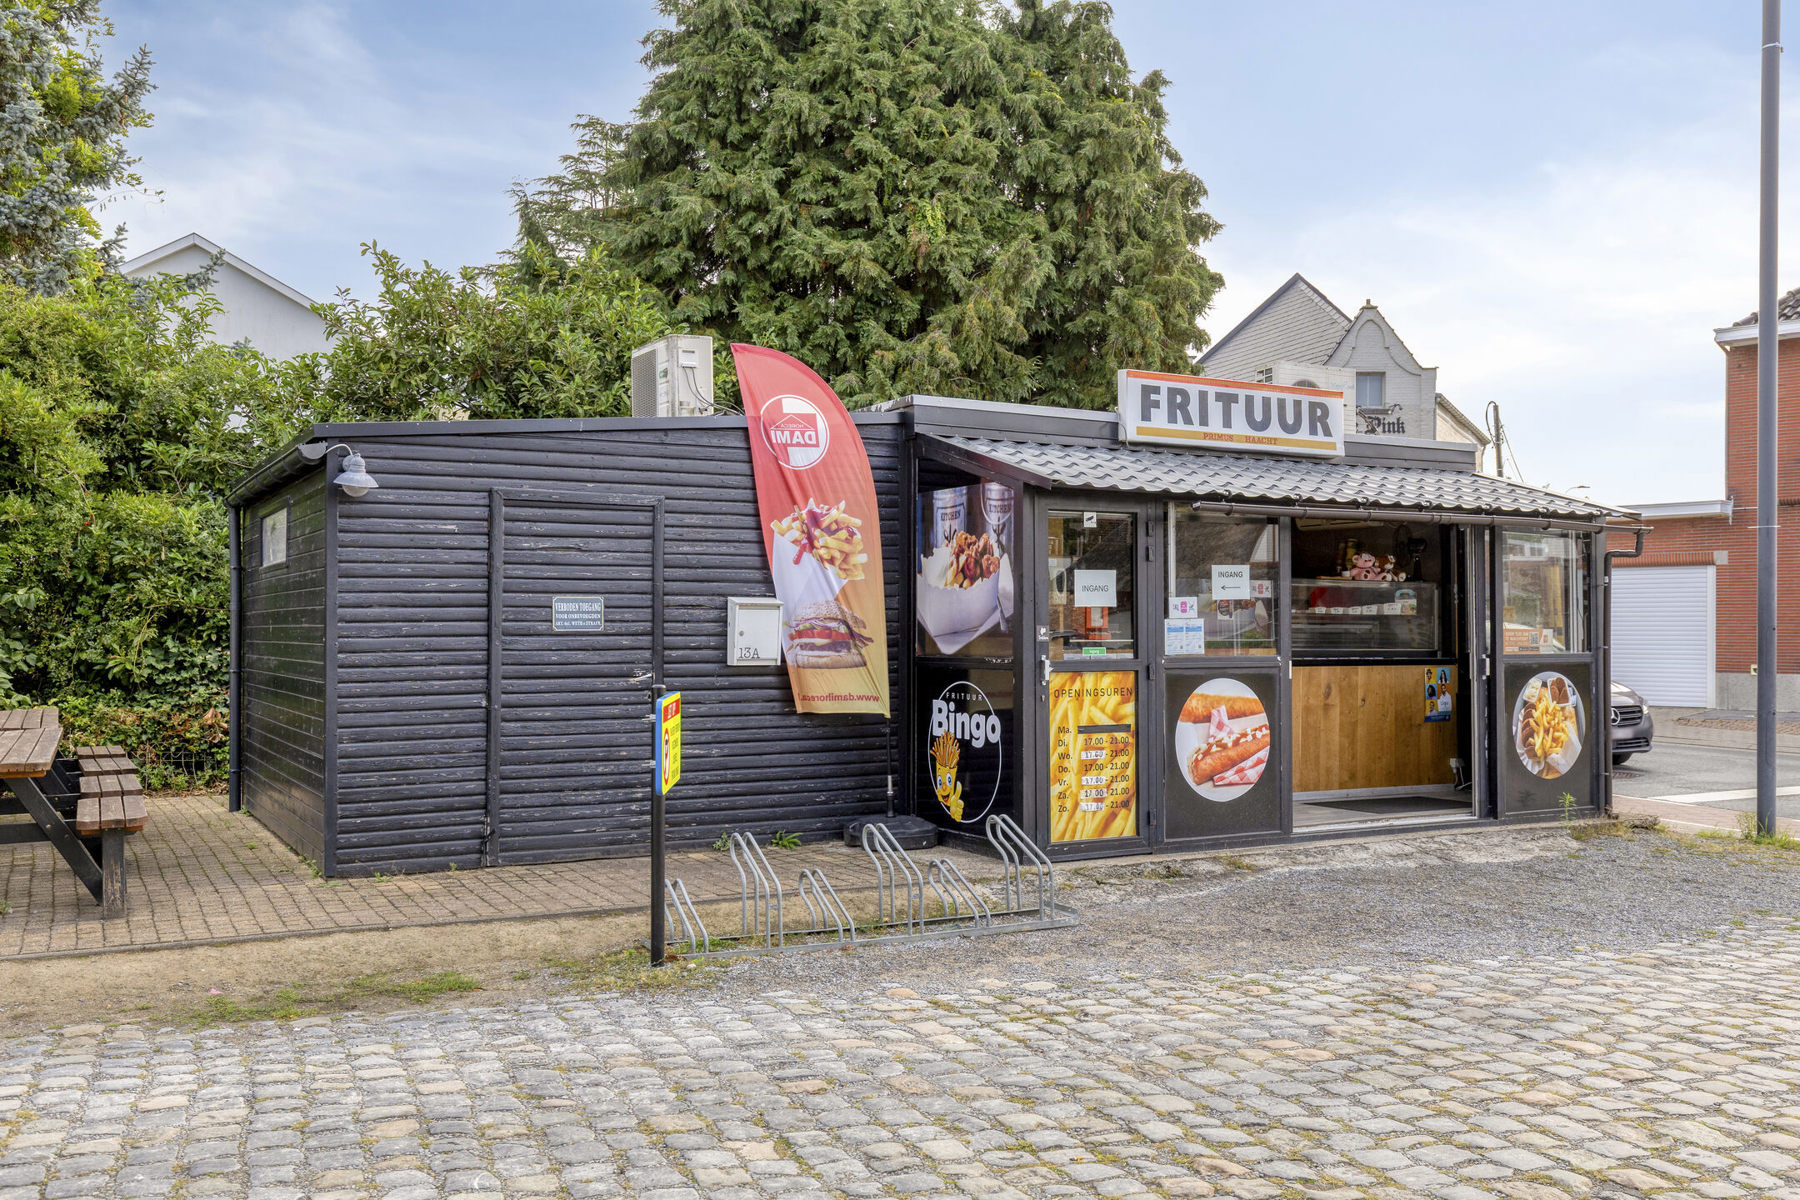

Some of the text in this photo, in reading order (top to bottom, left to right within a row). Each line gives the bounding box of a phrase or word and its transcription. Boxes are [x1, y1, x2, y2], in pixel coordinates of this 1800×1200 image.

[1140, 383, 1333, 438] FRITUUR
[1365, 416, 1406, 435] Pink
[1203, 432, 1234, 442] PRIMUS
[738, 647, 760, 659] 13A
[946, 692, 983, 701] FRITUUR
[1053, 687, 1133, 699] OPENINGSUREN
[932, 699, 1001, 748] Bingo
[1058, 726, 1072, 734] Ma.
[1058, 739, 1068, 747] Di.
[1084, 737, 1104, 746] 17.00
[1058, 752, 1073, 760] Wo.
[1058, 765, 1071, 773] Do.
[1084, 763, 1104, 771] 17.00
[1110, 762, 1130, 770] 21.00
[1110, 775, 1130, 783] 21.00
[1058, 792, 1069, 800] Za.
[1110, 787, 1130, 796] 21.00
[1058, 805, 1070, 813] Zo.
[1110, 800, 1130, 809] 21.00
